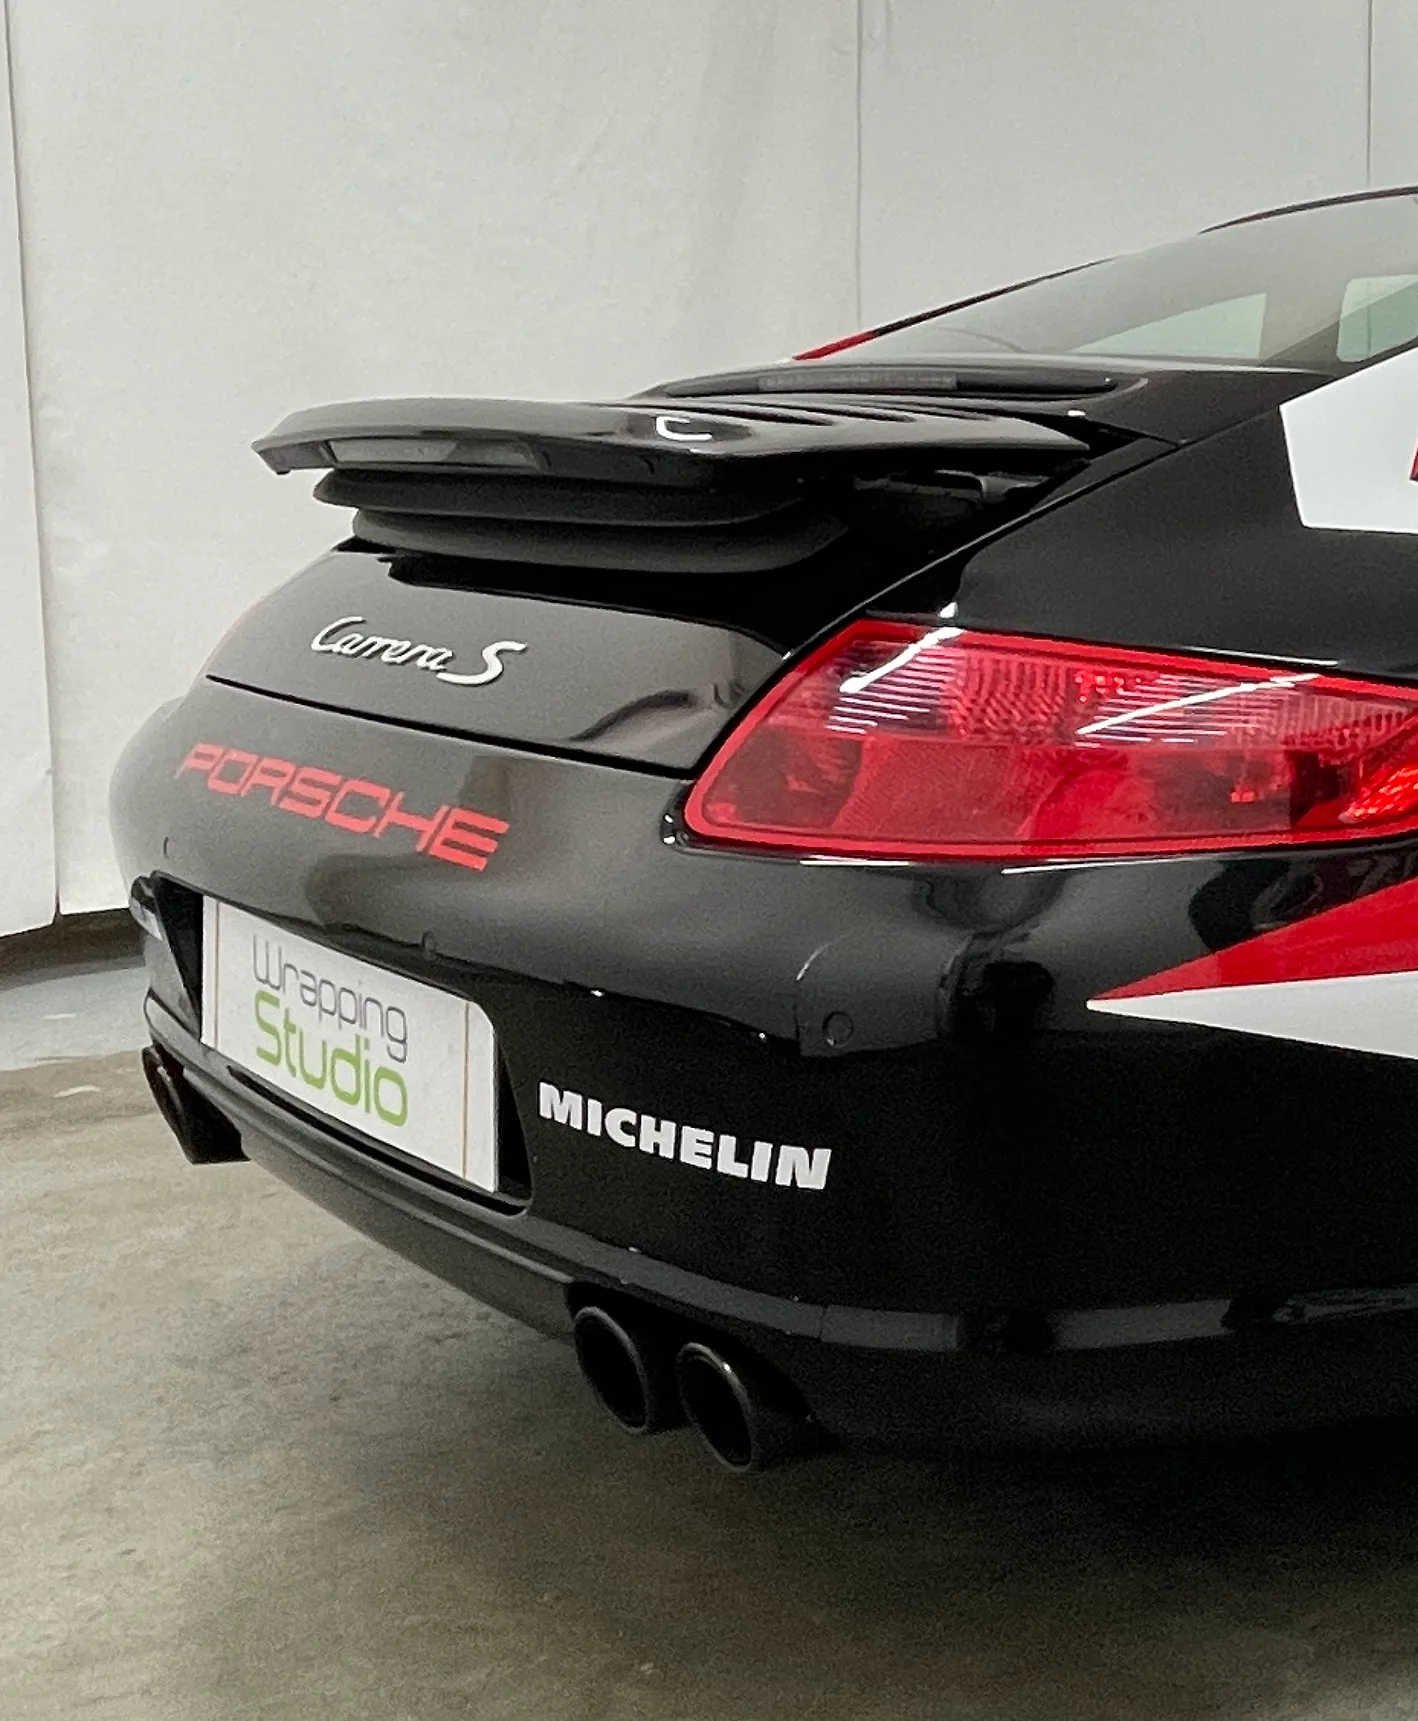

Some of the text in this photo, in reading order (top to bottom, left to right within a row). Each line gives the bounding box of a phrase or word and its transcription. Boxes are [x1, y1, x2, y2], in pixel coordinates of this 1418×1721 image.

[310, 616, 528, 685] Carrera S
[175, 743, 508, 871] PORSCHE
[253, 934, 408, 1064] Wrapping
[254, 989, 408, 1127] Studio
[538, 1083, 832, 1190] MICHELIN
